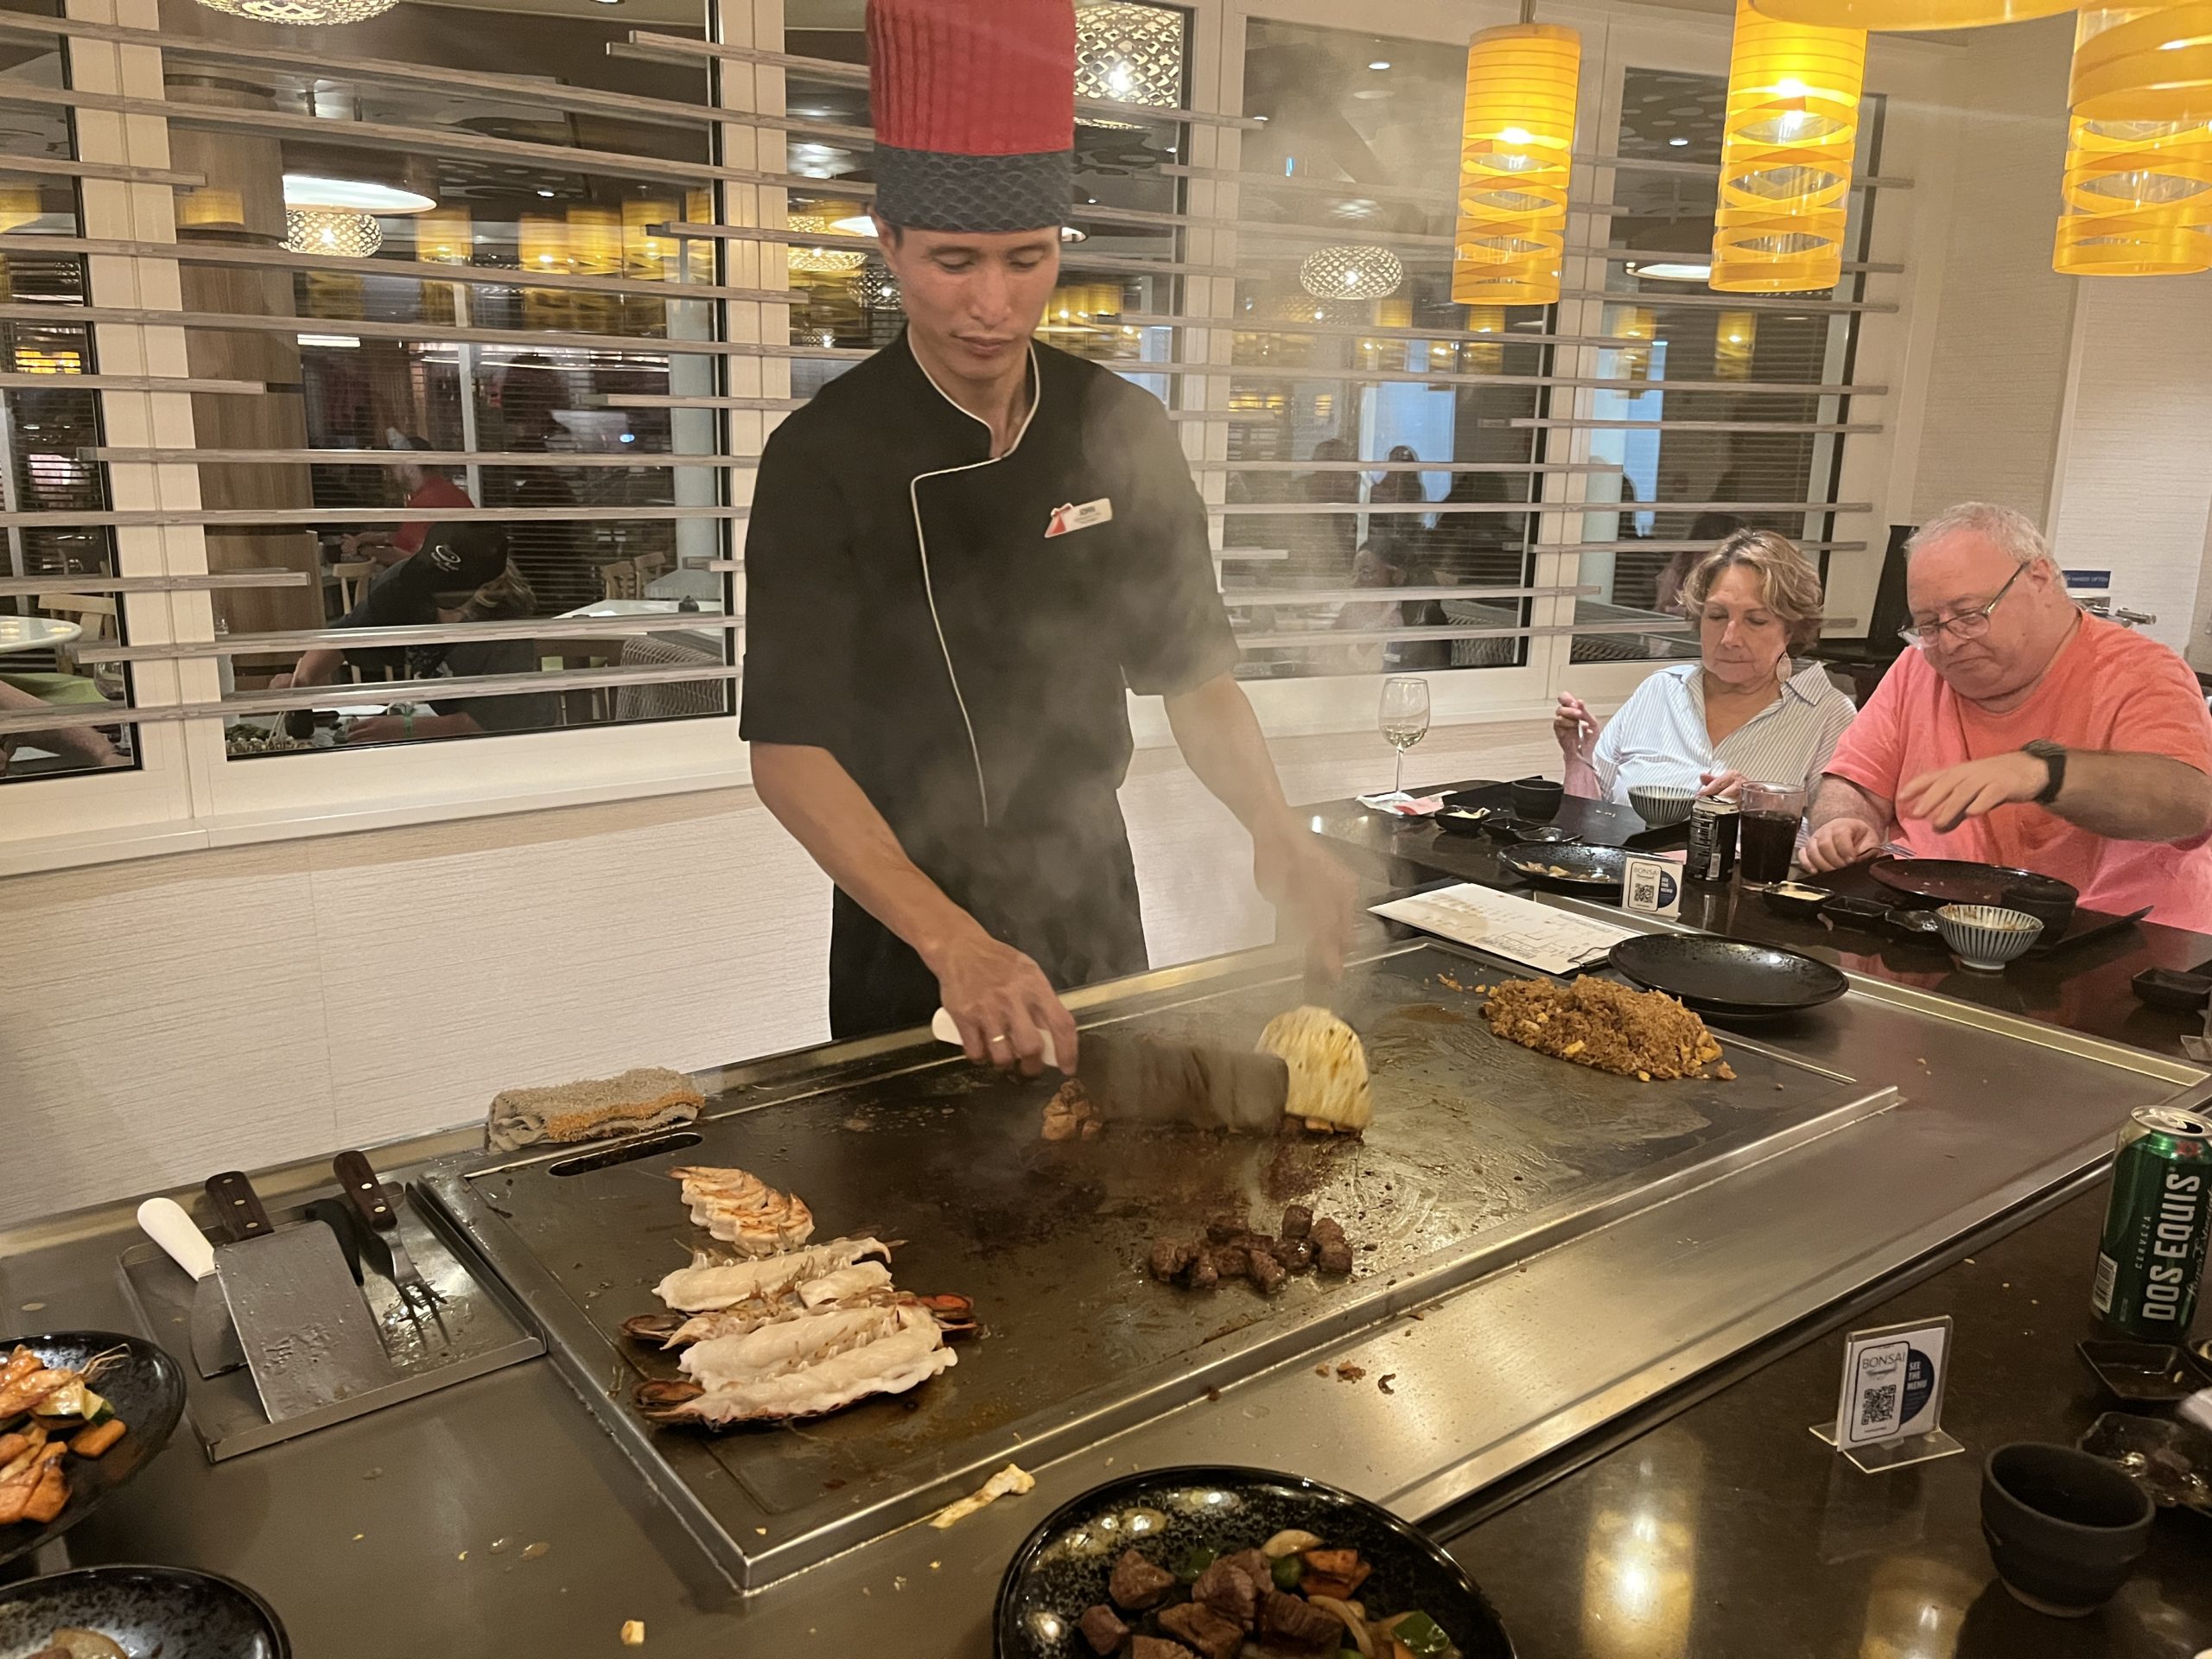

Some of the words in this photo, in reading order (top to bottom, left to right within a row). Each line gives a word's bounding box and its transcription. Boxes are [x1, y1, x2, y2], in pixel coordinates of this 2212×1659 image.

[2153, 1173, 2201, 1259] EQUIS
[2135, 1217, 2152, 1269] CERVEZA
[2142, 1266, 2183, 1320] DOS
[1862, 1351, 1905, 1369] BONSAI
[1910, 1361, 1921, 1370] SEE
